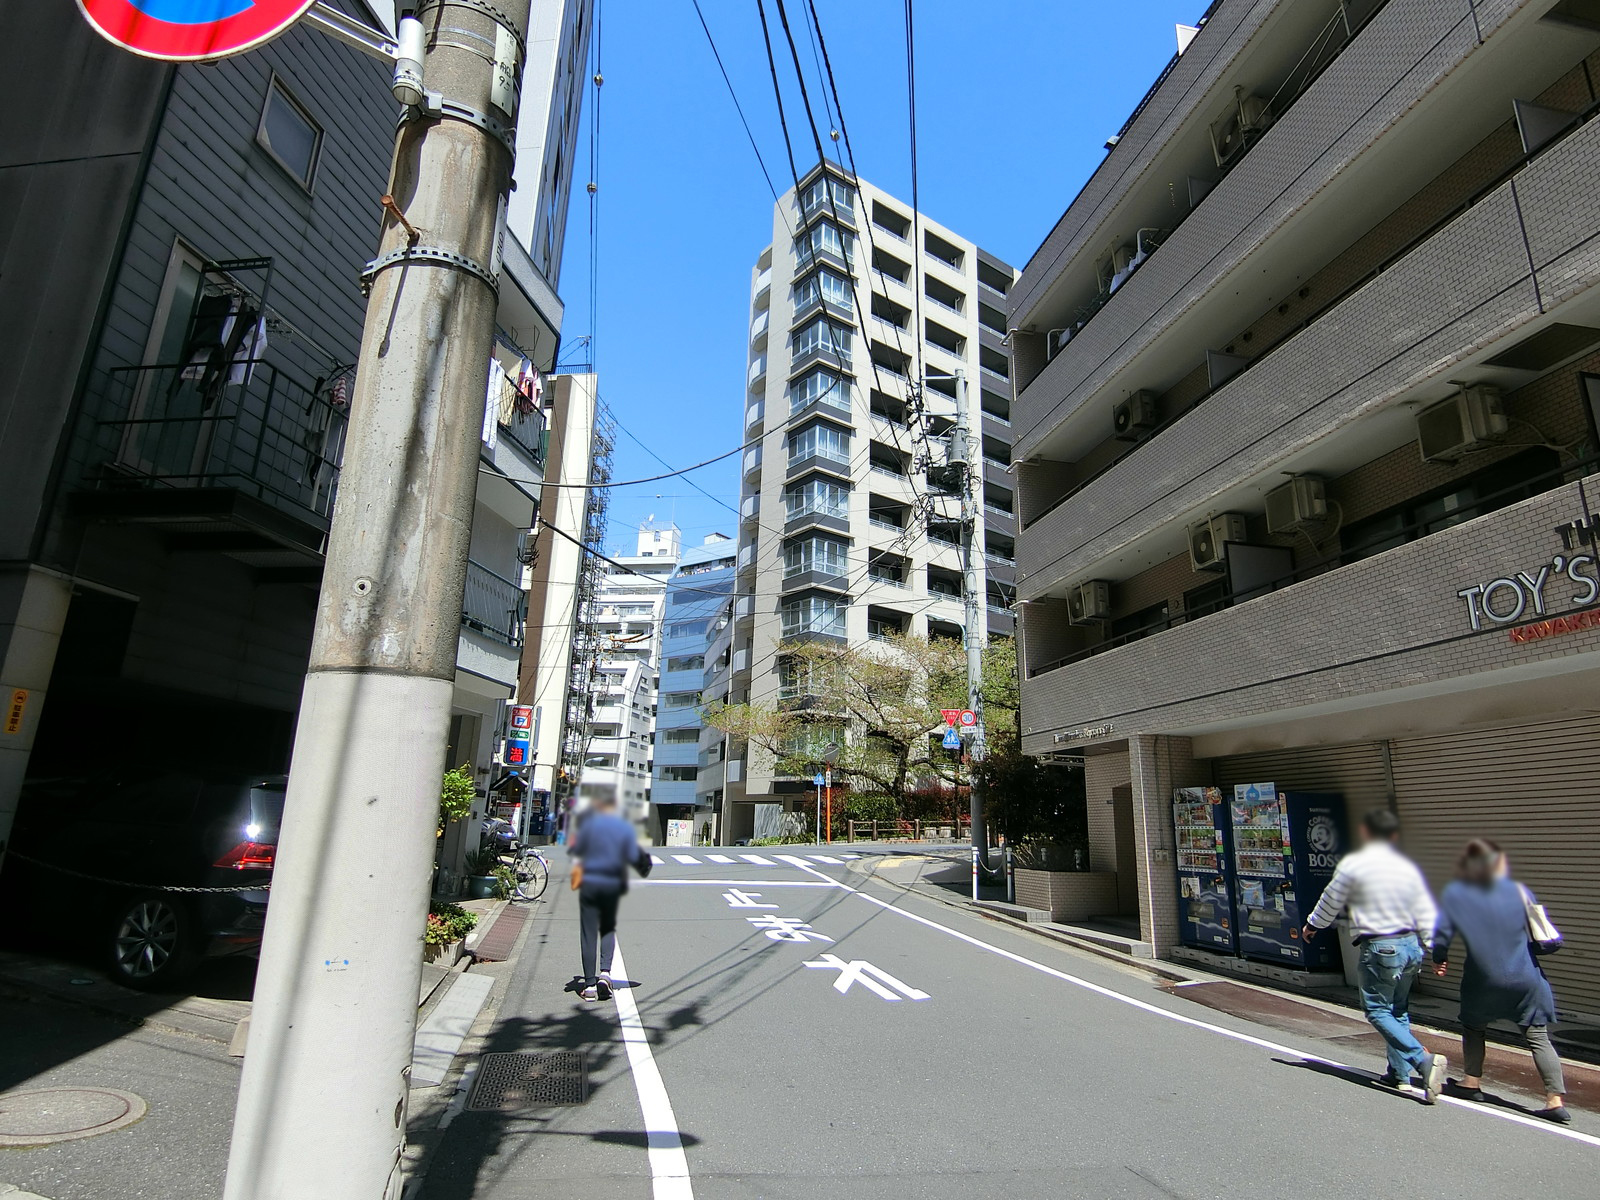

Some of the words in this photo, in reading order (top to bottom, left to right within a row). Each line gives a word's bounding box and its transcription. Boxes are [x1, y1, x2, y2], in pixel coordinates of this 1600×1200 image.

[1457, 554, 1600, 631] TOY'S
[516, 717, 526, 725] P
[962, 714, 973, 722] 30
[510, 748, 523, 762] 満
[722, 888, 932, 1002] 止まれ
